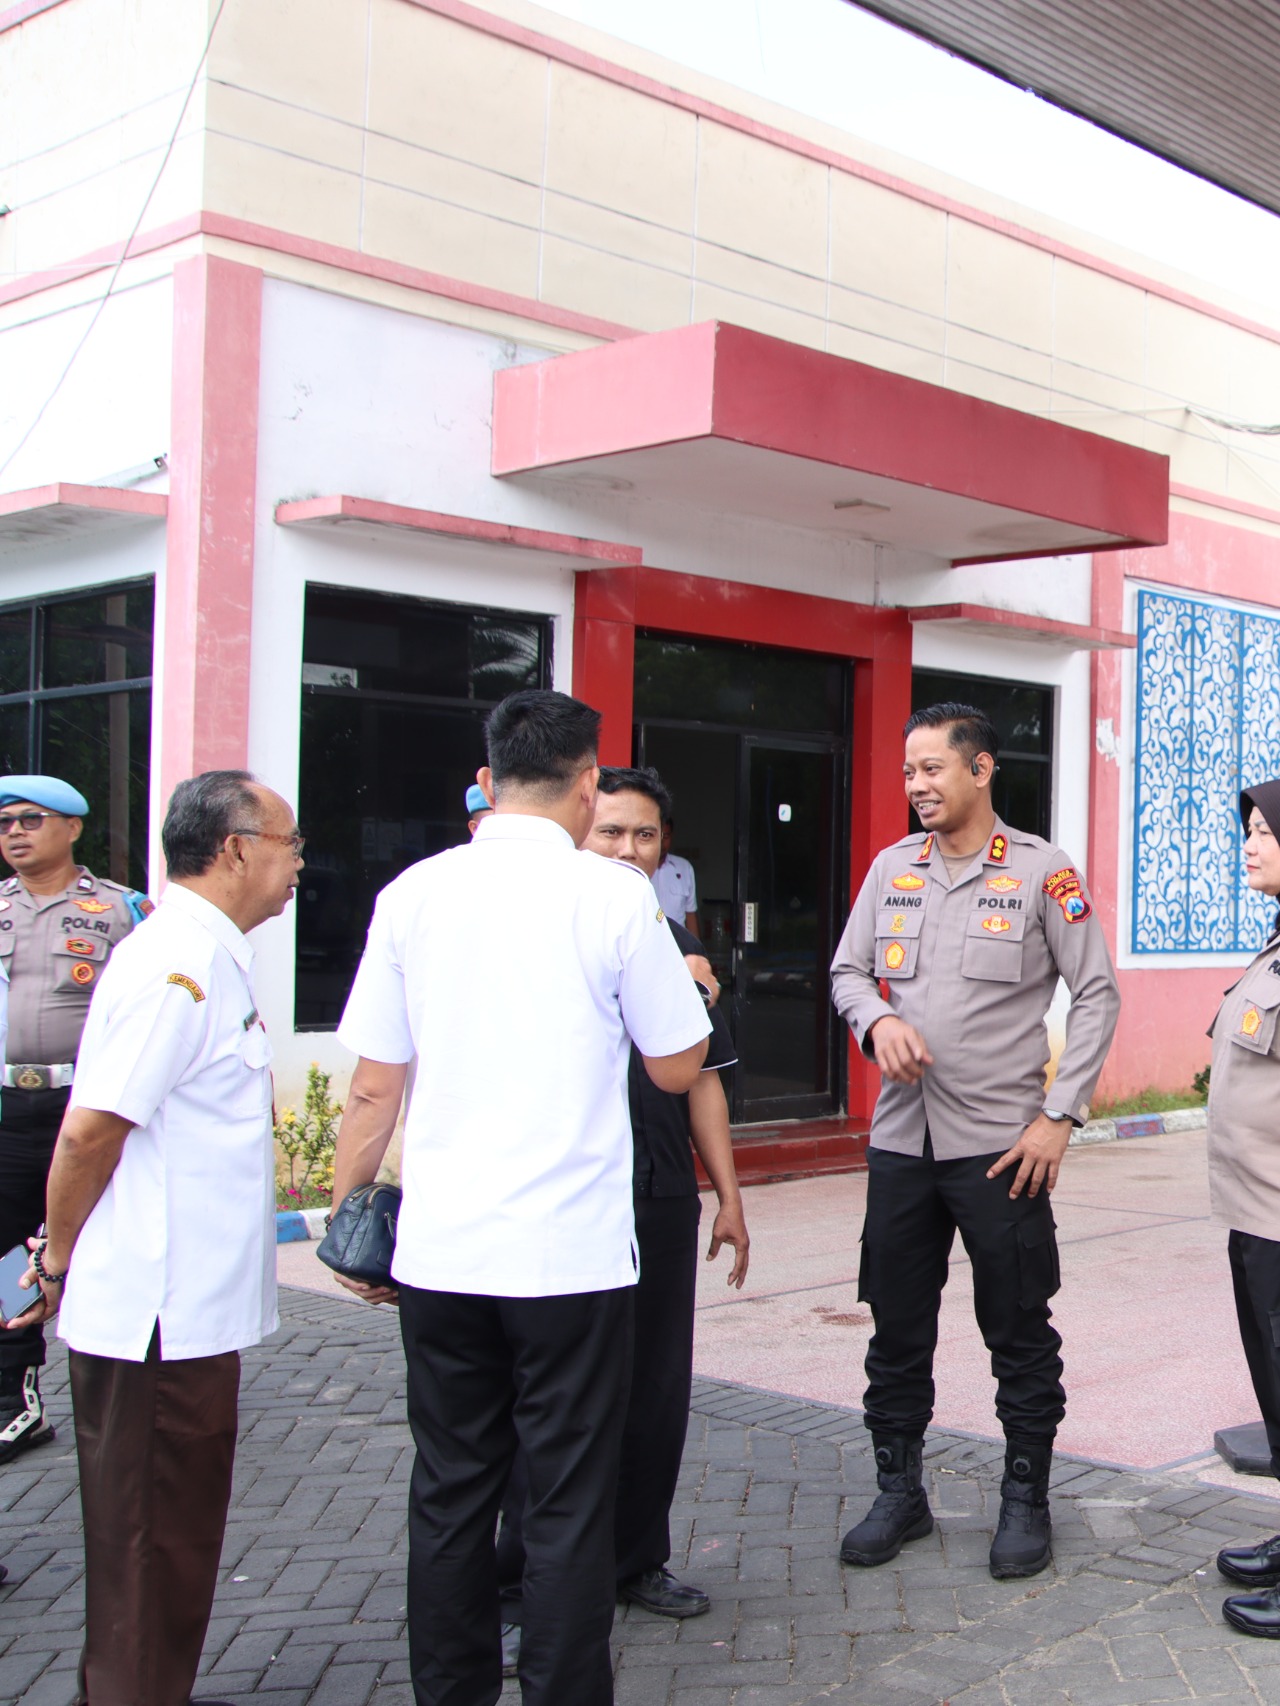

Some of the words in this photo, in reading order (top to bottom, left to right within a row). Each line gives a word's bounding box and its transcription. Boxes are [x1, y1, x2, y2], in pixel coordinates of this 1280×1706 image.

[884, 895, 922, 908] ANANG
[978, 897, 1022, 910] POLRI
[61, 916, 111, 934] POLRI
